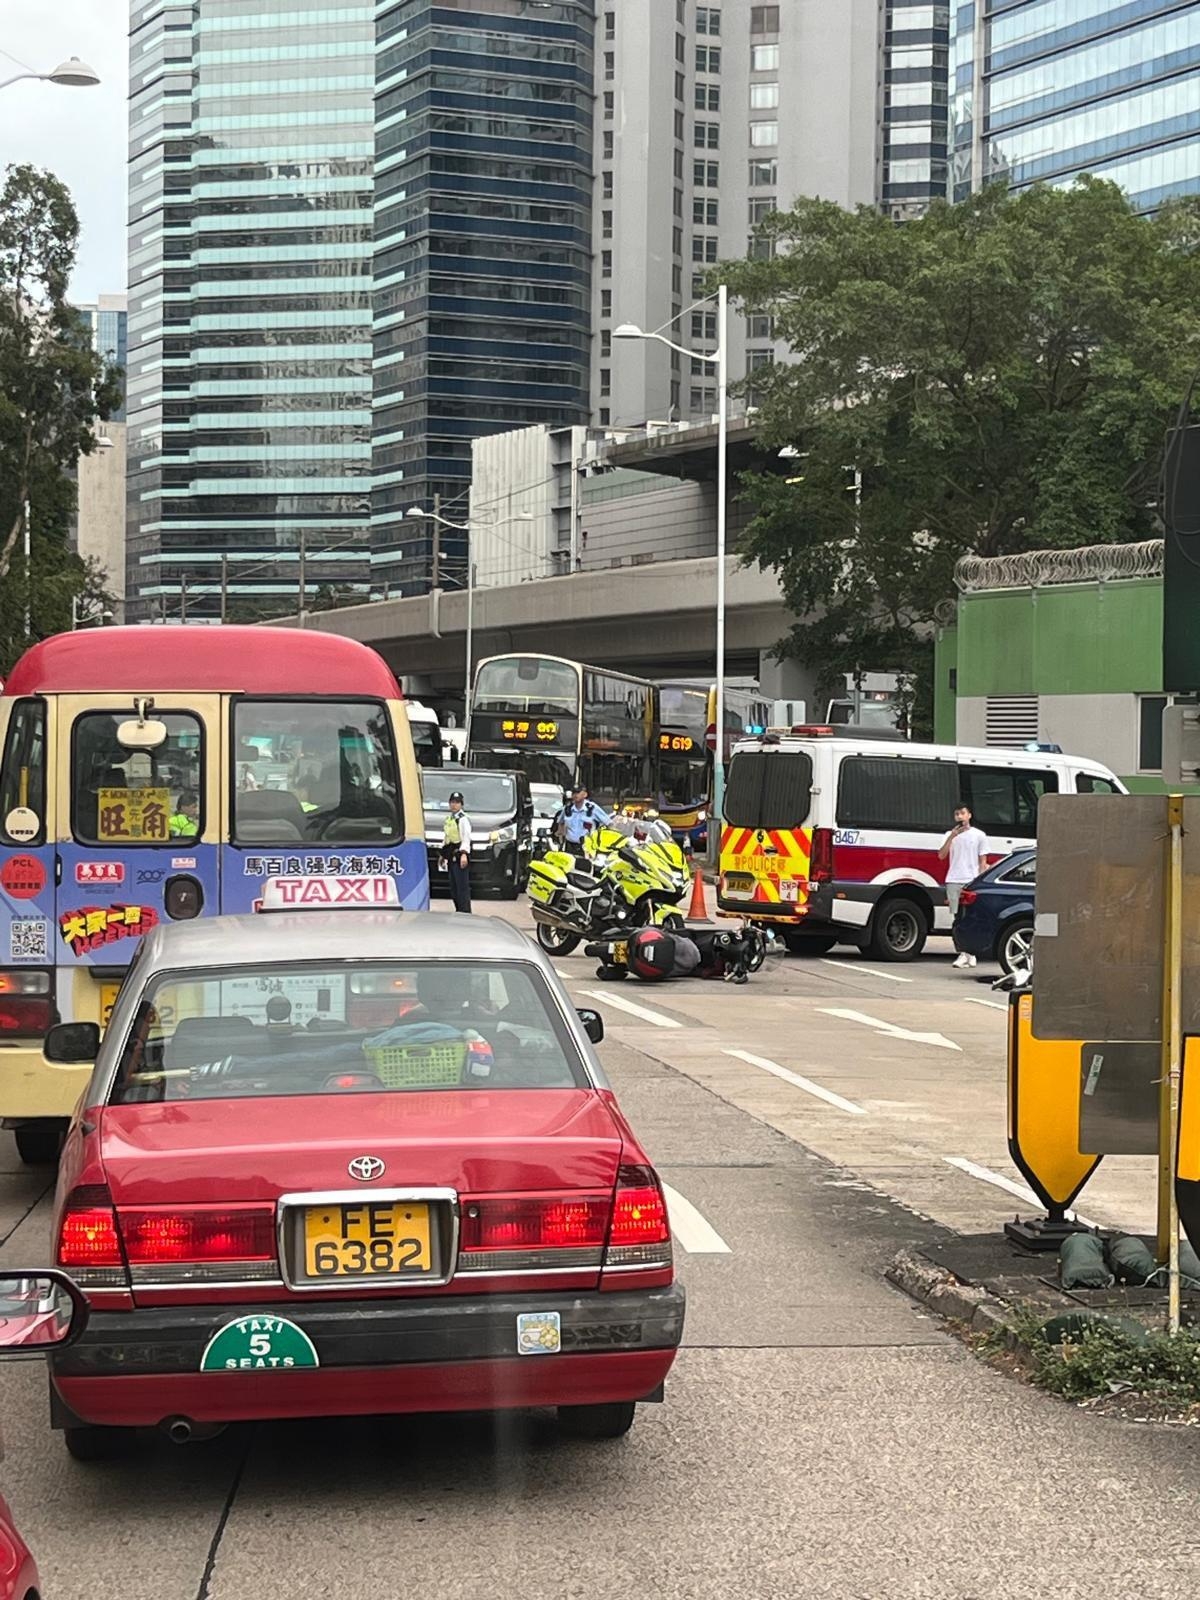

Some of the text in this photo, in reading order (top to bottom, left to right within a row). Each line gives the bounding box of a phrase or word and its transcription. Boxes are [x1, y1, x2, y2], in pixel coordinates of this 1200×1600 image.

[672, 737, 693, 750] 619
[101, 802, 167, 838] 旺角
[834, 830, 860, 844] 8467
[12, 859, 33, 867] PCL
[741, 856, 776, 872] POLICE
[276, 879, 388, 903] TAXI
[786, 891, 791, 900] 4
[341, 1203, 394, 1239] FE
[315, 1239, 423, 1274] 6382
[236, 1319, 283, 1334] TAXI
[249, 1334, 271, 1356] 5
[225, 1357, 295, 1369] SEATS
